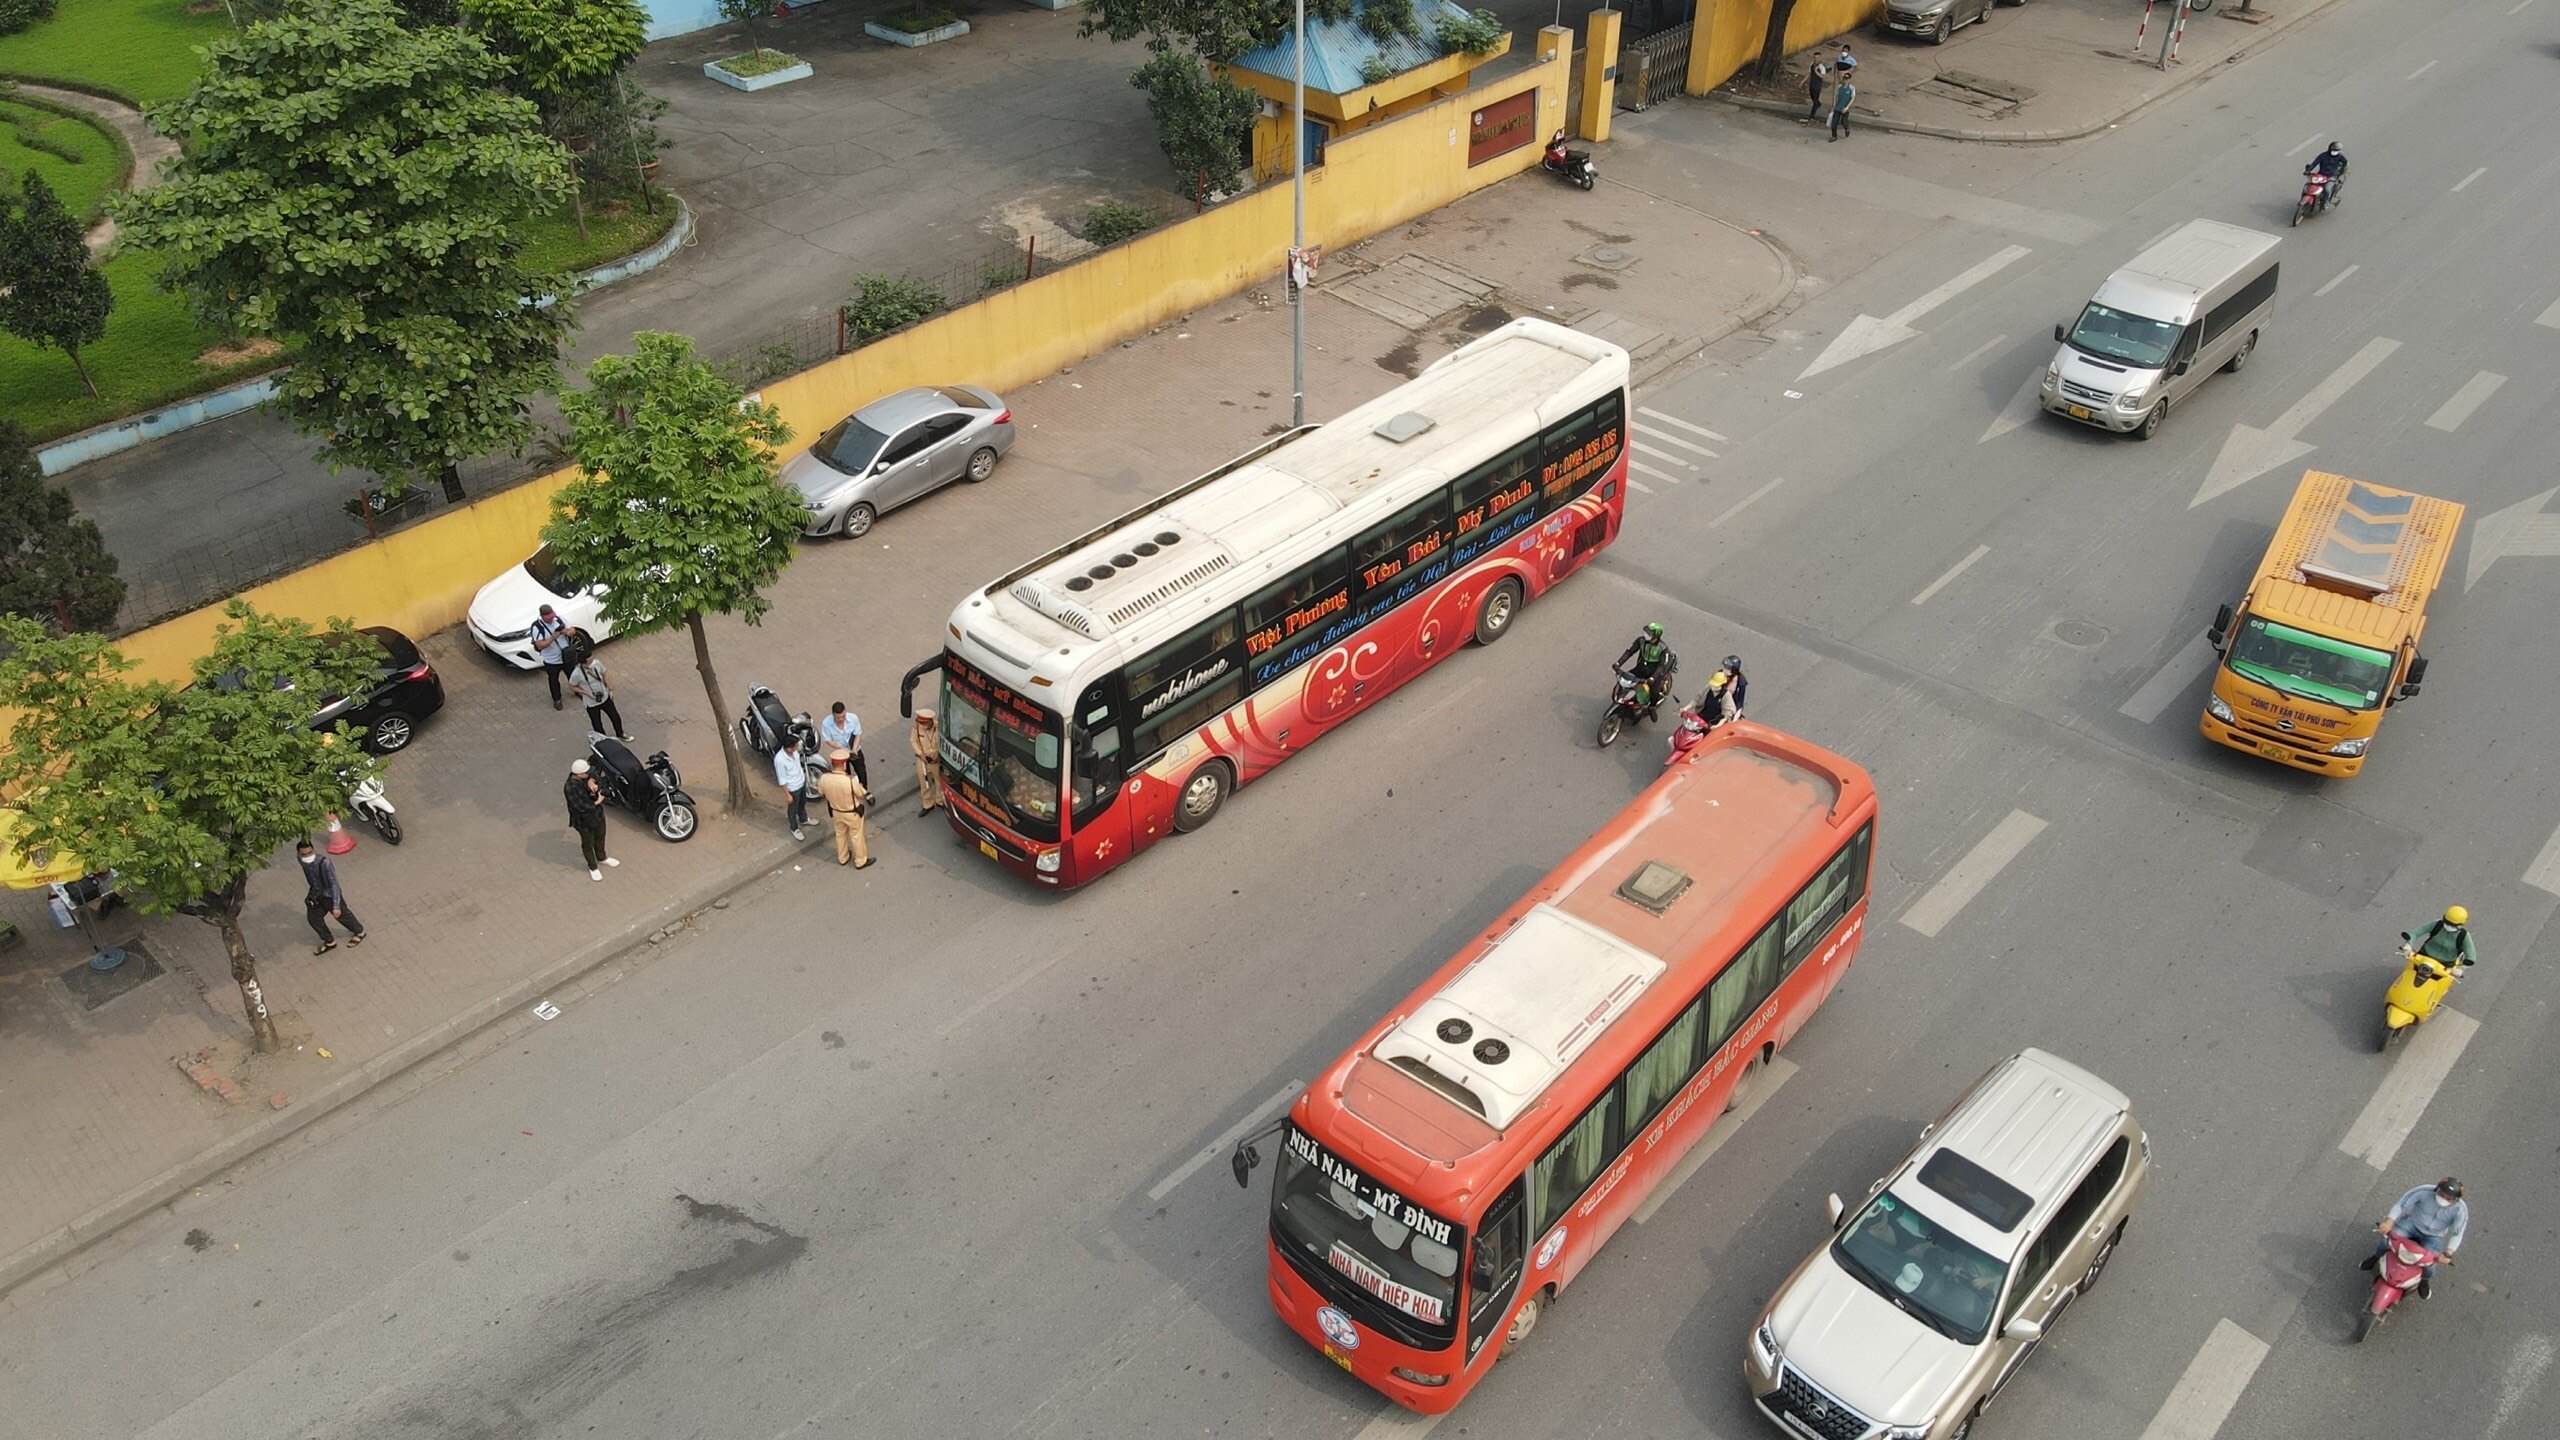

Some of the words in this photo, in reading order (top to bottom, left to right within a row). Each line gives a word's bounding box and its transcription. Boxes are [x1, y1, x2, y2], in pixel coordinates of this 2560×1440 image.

[1363, 558, 1402, 590] Yên
[1407, 529, 1441, 566] Bái
[1457, 505, 1484, 536] Mỹ
[1489, 479, 1532, 518] Đình
[1246, 622, 1282, 656] Việt
[1285, 587, 1348, 635] Phương
[1257, 663, 1281, 683] Xe
[1284, 640, 1319, 668] chạy
[1370, 594, 1394, 614] cao
[1452, 543, 1478, 568] Bài
[1486, 524, 1511, 547] Lào
[1513, 507, 1536, 529] Cai
[1142, 658, 1230, 718] mobihome
[2270, 703, 2278, 713] TY
[1289, 1127, 1319, 1167] NHÃ
[1321, 1153, 1359, 1193] NAM
[1373, 1188, 1401, 1217] MỸ
[1402, 1205, 1451, 1244] ĐÌNH
[1355, 1268, 1381, 1294] NAM
